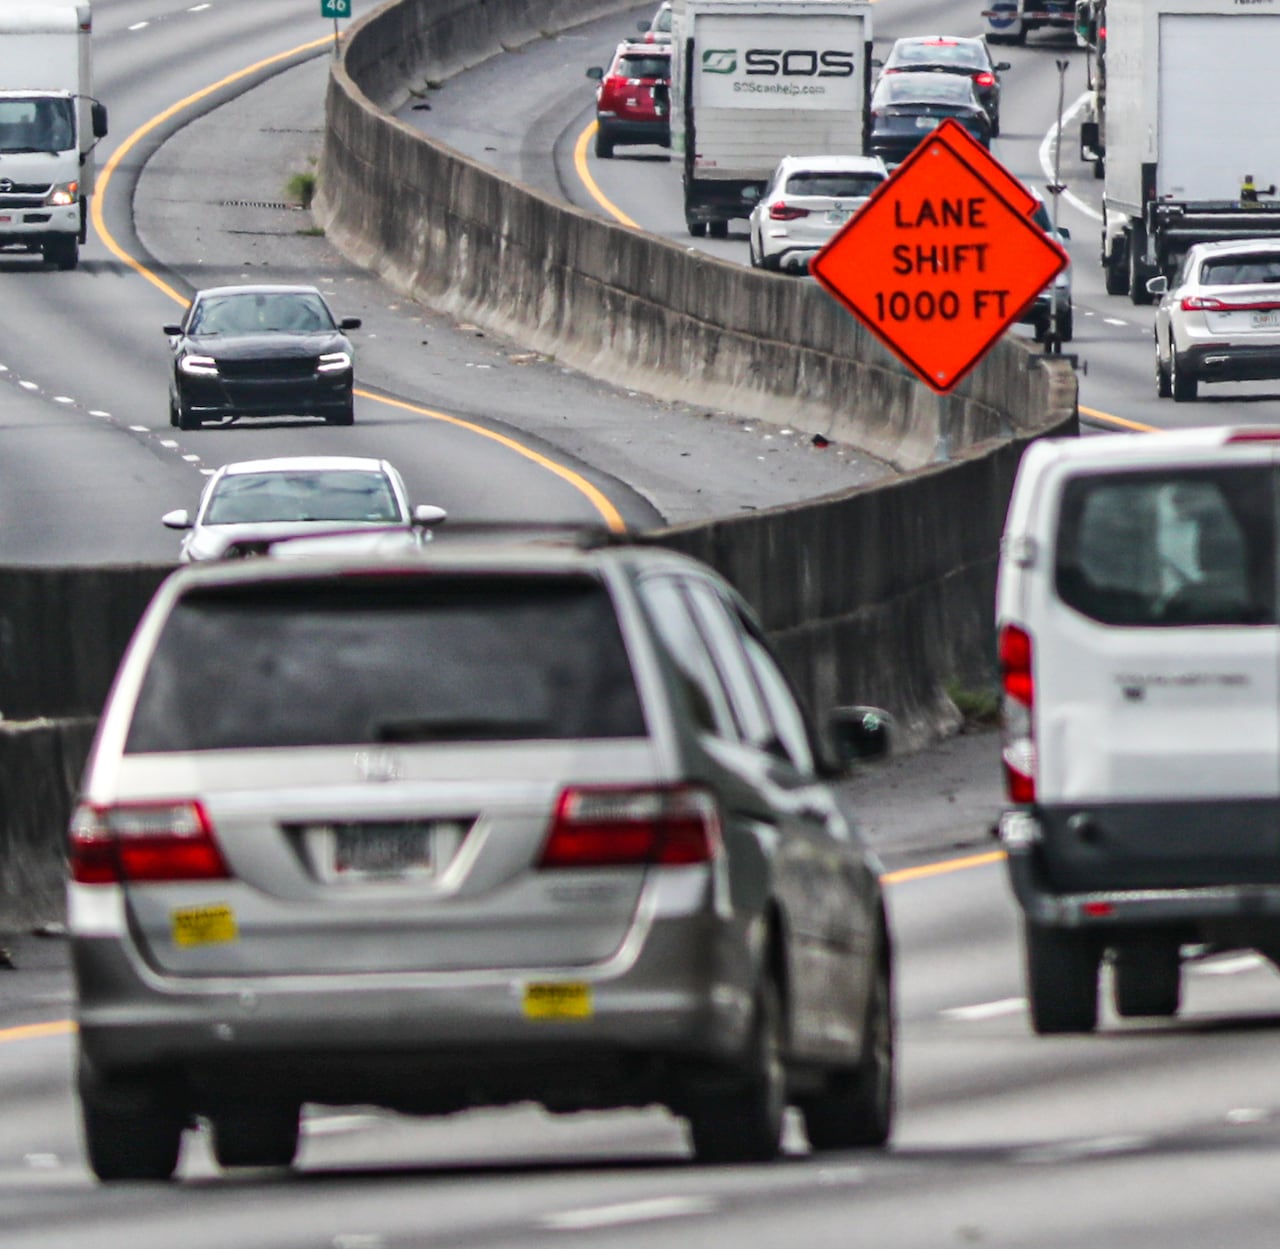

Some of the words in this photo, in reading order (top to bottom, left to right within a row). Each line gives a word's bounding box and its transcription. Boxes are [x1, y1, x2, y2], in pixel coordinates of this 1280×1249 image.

[745, 49, 854, 77] SOS
[894, 199, 987, 228] LANE
[892, 244, 988, 275] SHIFT
[875, 290, 960, 321] 1000
[974, 289, 1010, 319] FT
